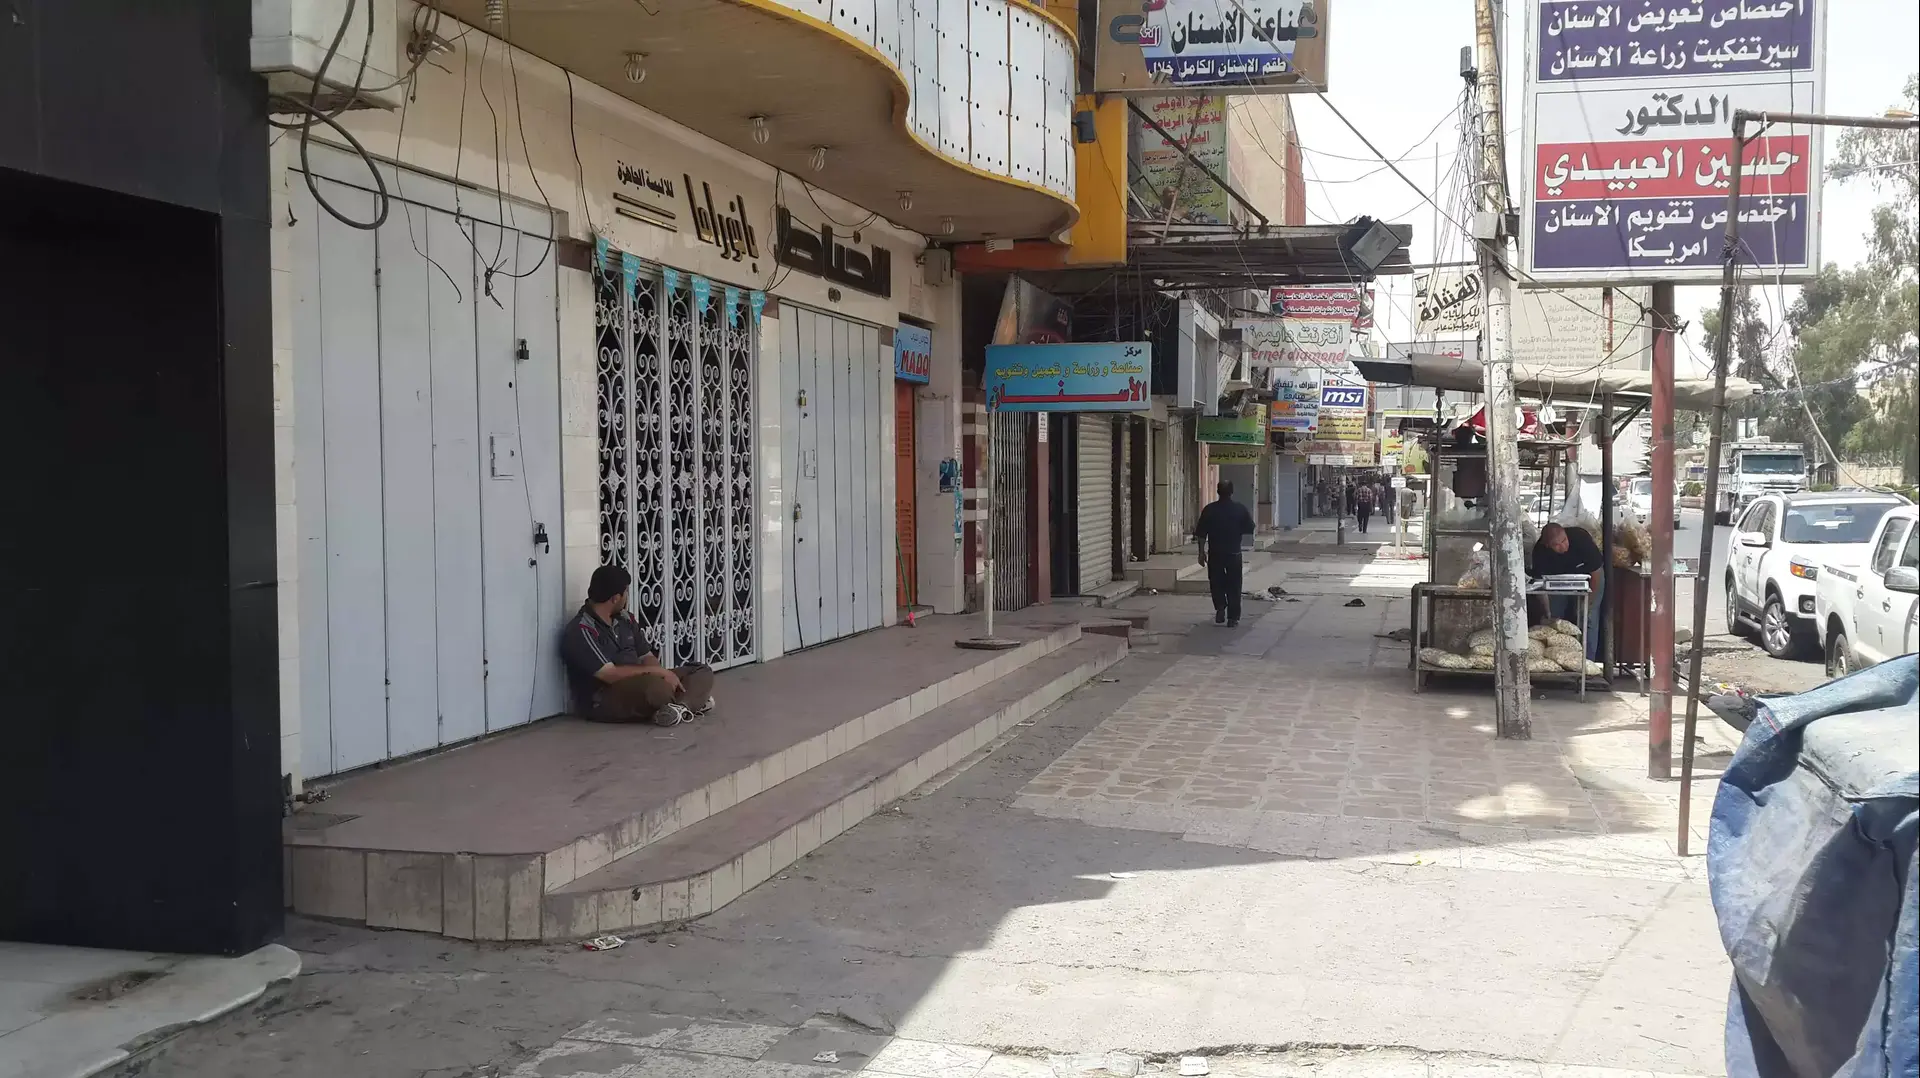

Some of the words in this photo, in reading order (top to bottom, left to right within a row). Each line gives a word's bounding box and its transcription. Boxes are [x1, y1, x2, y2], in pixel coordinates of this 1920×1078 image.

[1171, 6, 1244, 55] الاسنان
[1252, 7, 1300, 42] ناعة
[1547, 3, 1622, 36] الاسنان
[1627, 0, 1704, 32] تعويض
[1178, 59, 1215, 79] الكامل
[1217, 57, 1258, 78] الاسنان
[1262, 57, 1288, 76] طقم
[1550, 45, 1622, 76] الاسنان
[1629, 40, 1687, 70] زراعة
[1615, 91, 1730, 137] الدكتور
[617, 159, 645, 191] الجاهزة
[1543, 144, 1686, 197] العبيدي
[1694, 144, 1800, 189] حسين
[683, 173, 761, 275] بانوراما
[1543, 203, 1620, 233] الاسنان
[1627, 200, 1695, 233] تقويم
[1700, 199, 1797, 231] اختصص
[1627, 235, 1709, 264] امريكا
[900, 349, 929, 376] MADO
[1124, 346, 1142, 357] مركز
[1252, 348, 1285, 364] ernet
[1287, 349, 1347, 364] diamond
[994, 362, 1029, 380] وتقويم
[1031, 362, 1061, 379] تجميل
[1063, 365, 1071, 378] و
[1072, 361, 1100, 377] زراعة
[1100, 364, 1109, 377] و
[1110, 360, 1144, 374] صناعة
[1323, 391, 1363, 403] msi
